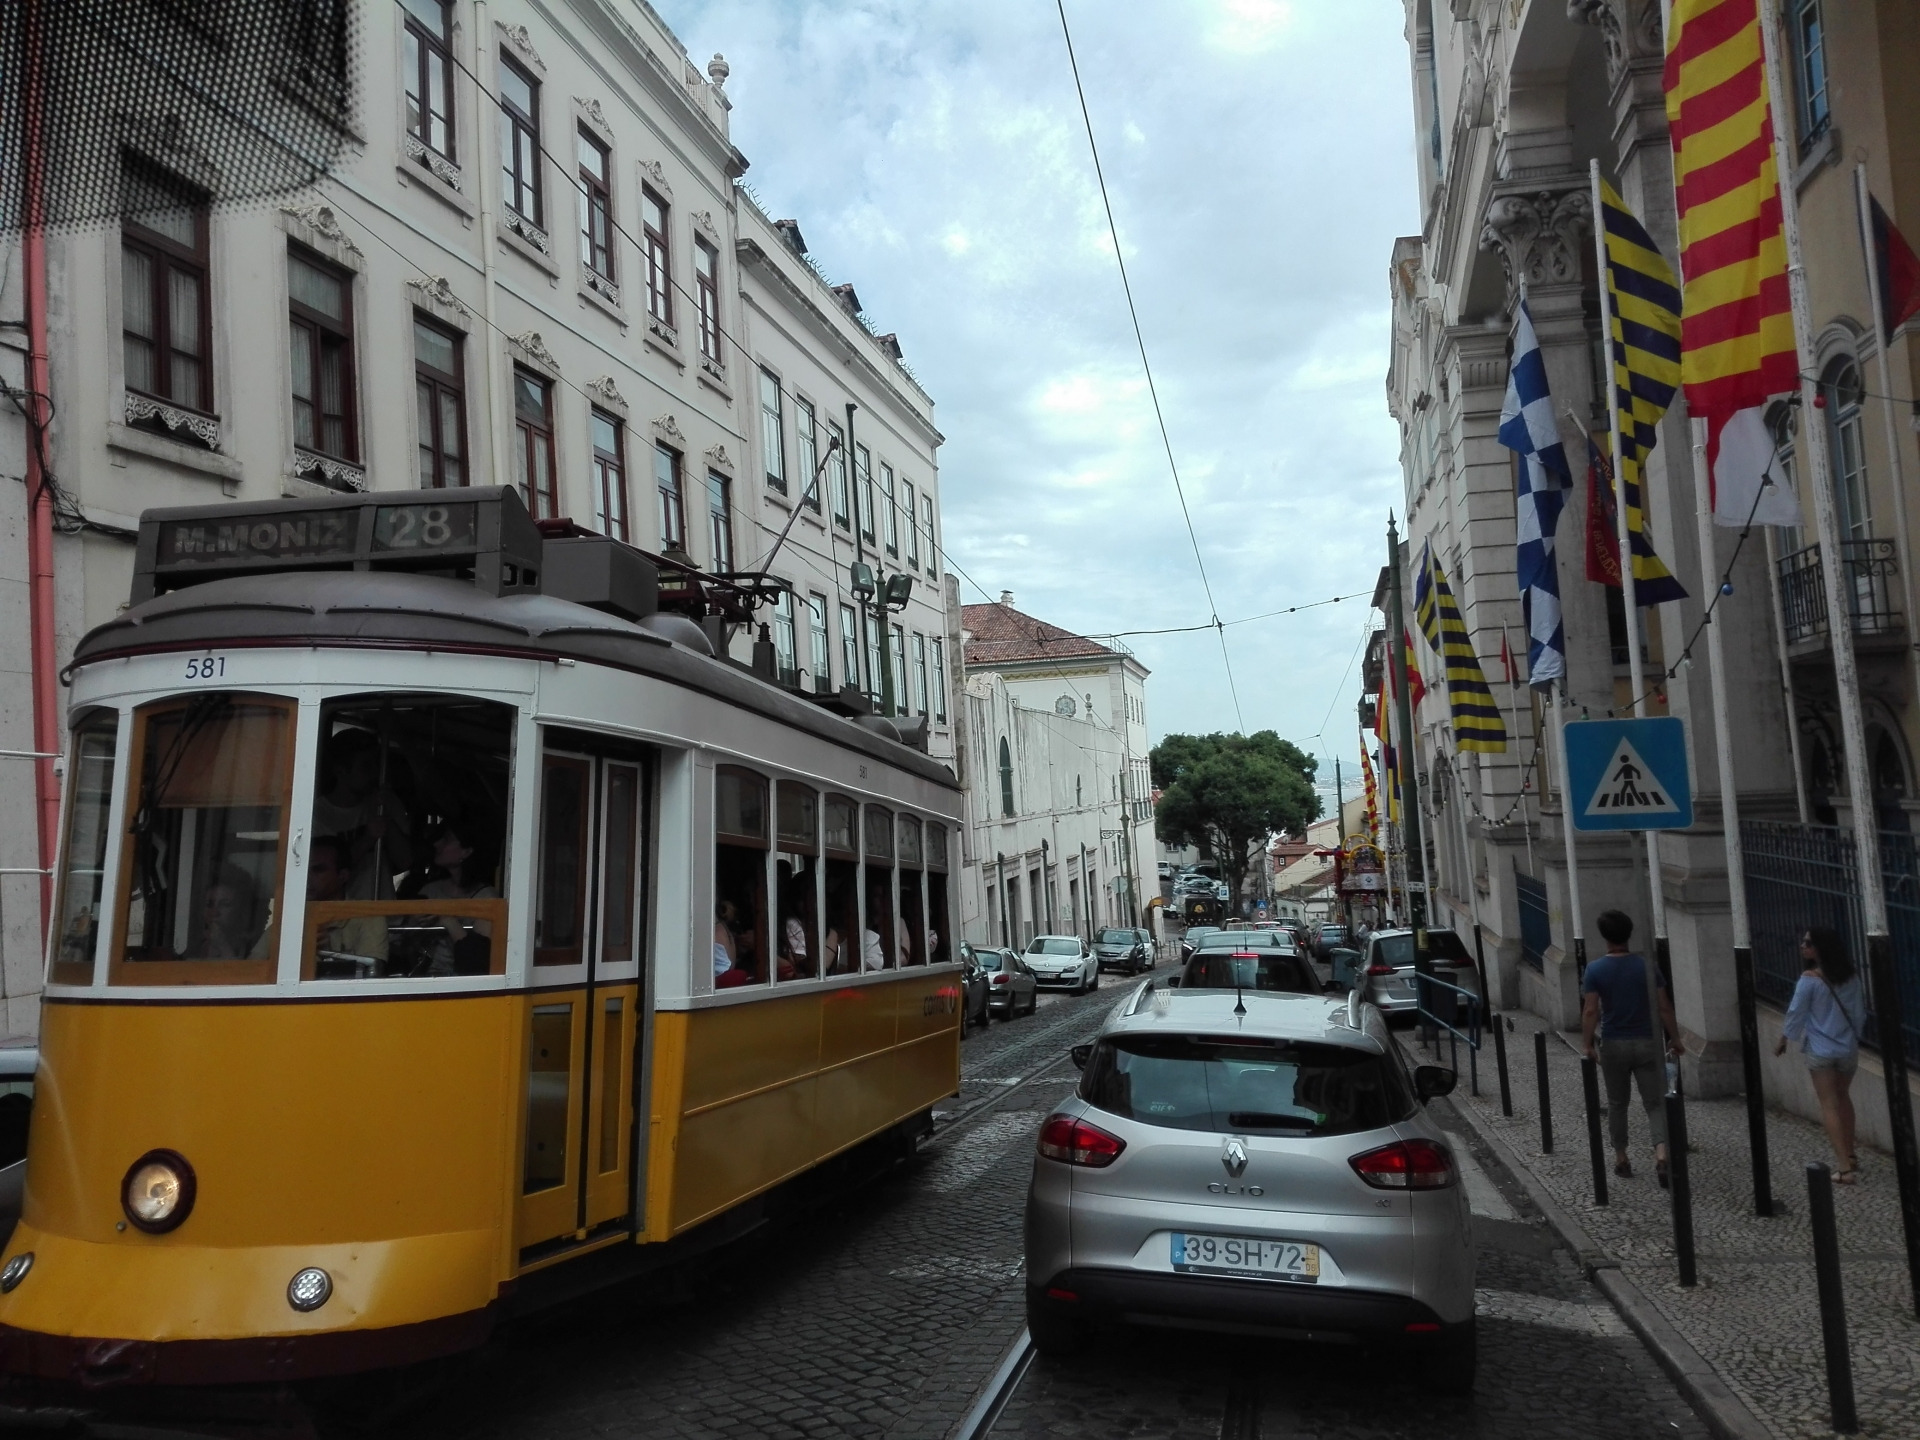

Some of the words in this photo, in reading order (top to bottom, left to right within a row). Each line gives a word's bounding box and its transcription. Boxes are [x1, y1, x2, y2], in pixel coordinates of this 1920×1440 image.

[388, 504, 452, 548] 28
[175, 517, 344, 554] M.MONIZ
[185, 656, 225, 679] 581
[859, 765, 868, 780] 581
[1207, 1182, 1264, 1197] CLIO
[1175, 1251, 1181, 1259] P
[1305, 1245, 1316, 1256] 14
